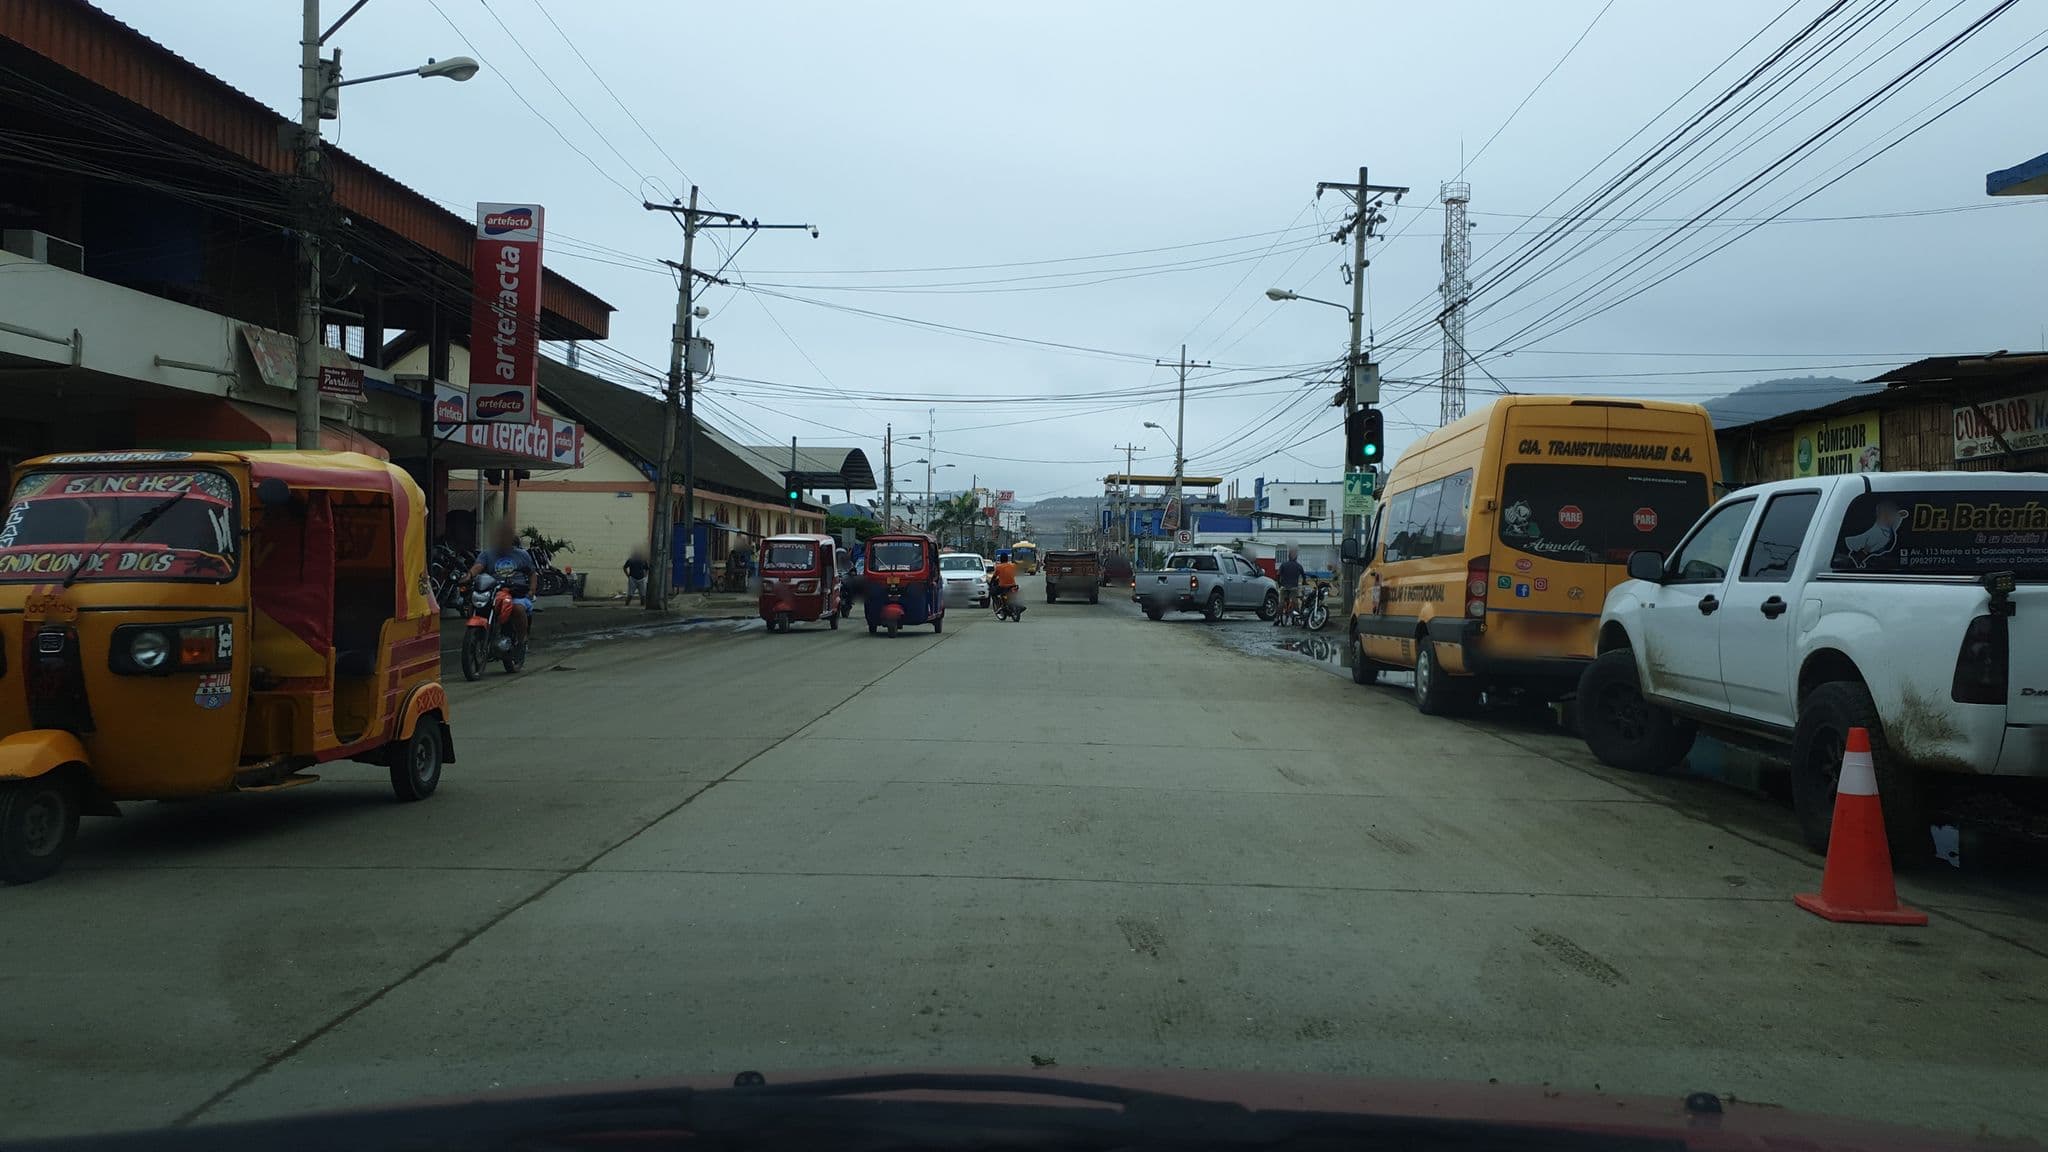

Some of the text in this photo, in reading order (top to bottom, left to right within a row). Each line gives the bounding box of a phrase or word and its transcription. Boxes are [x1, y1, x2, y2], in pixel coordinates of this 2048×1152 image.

[487, 215, 529, 228] artefacta
[491, 245, 521, 380] artefacta
[438, 404, 463, 422] artefacta
[478, 399, 521, 410] artefacta
[1817, 423, 1866, 453] COMEDOR
[1519, 440, 1542, 455] CIA.
[1671, 447, 1693, 462] S.A.
[1818, 453, 1853, 476] MARITZA
[64, 475, 193, 494] SANCHEZ
[1560, 511, 1582, 523] PARE
[1635, 514, 1656, 526] PARE
[1911, 503, 1949, 531] Dr.
[87, 552, 110, 572] DE
[118, 552, 176, 572] DIOS
